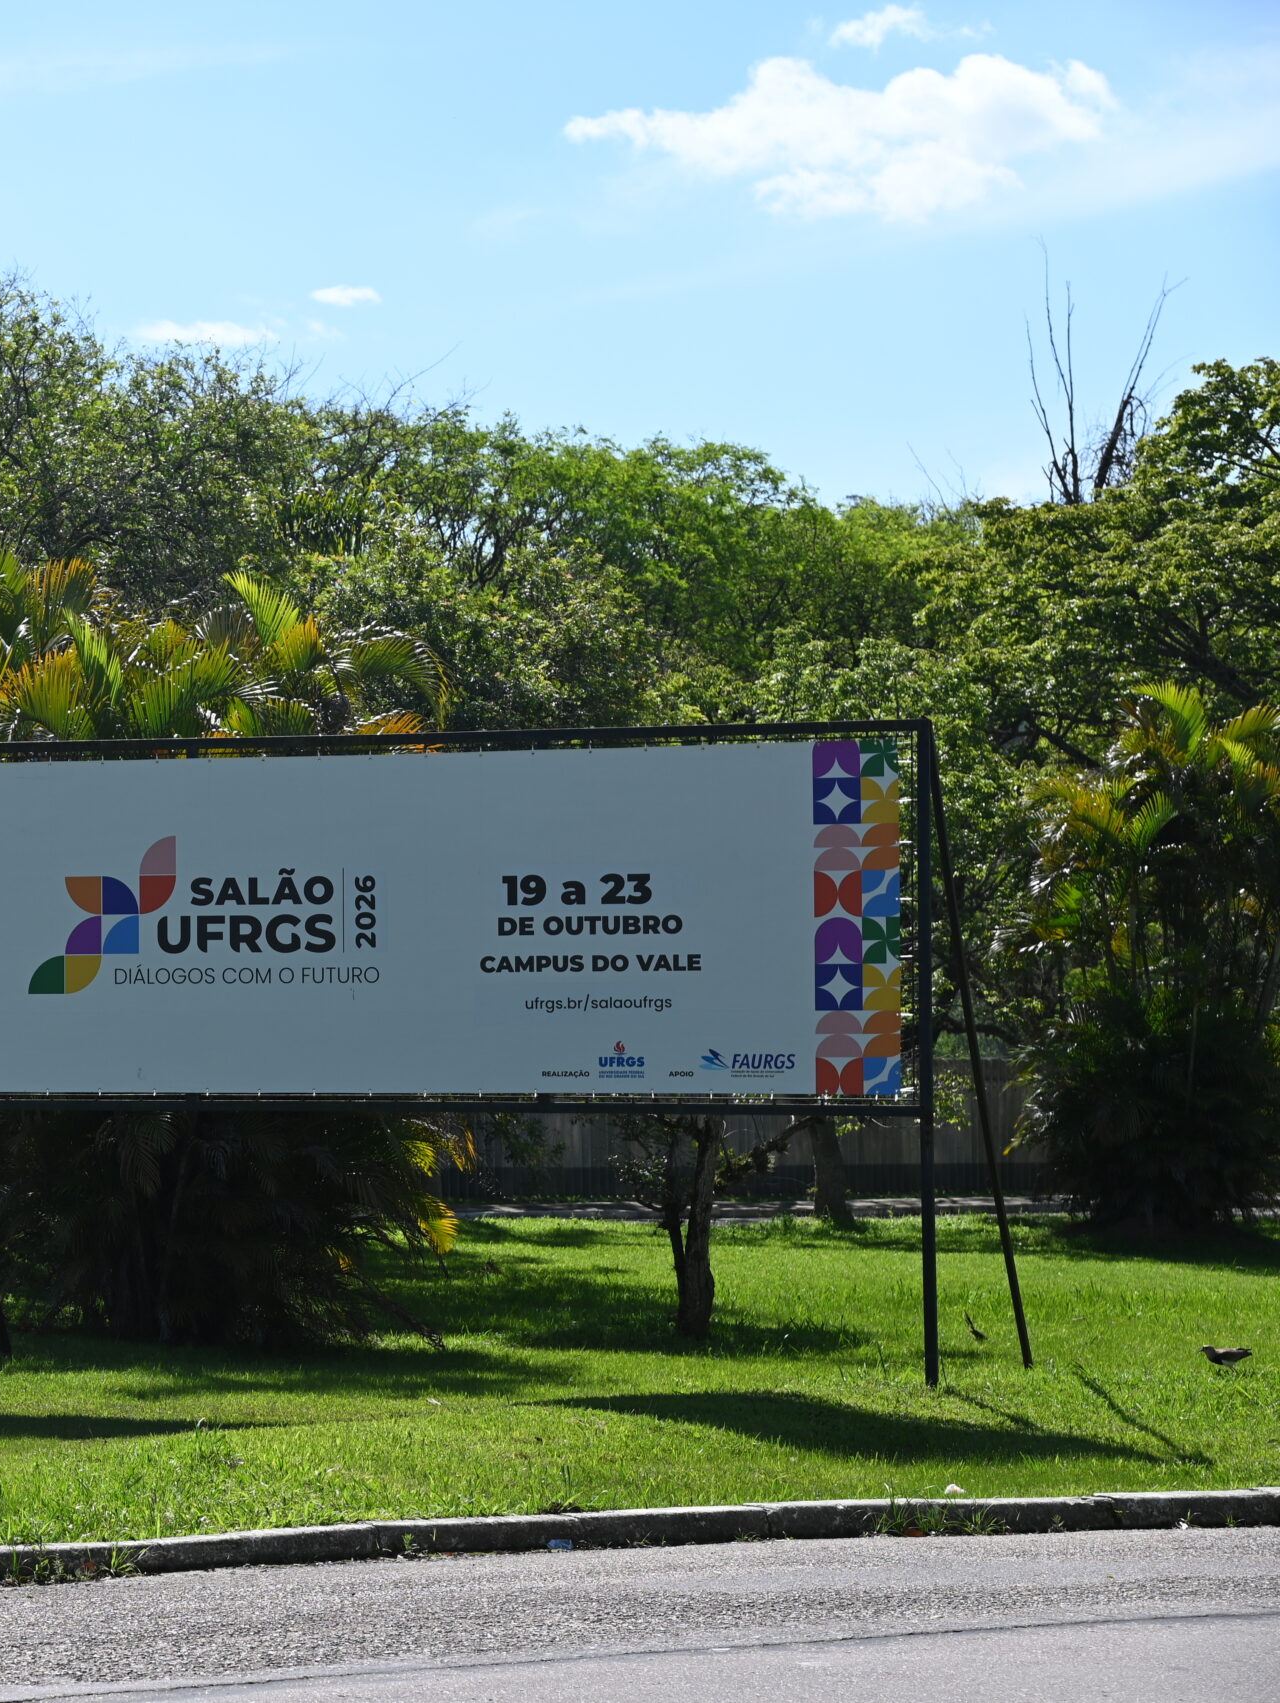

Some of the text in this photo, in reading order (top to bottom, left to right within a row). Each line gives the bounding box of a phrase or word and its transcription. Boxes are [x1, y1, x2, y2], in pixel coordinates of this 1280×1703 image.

[191, 868, 334, 906] SALÃO
[502, 874, 652, 906] 19 a 23
[355, 875, 376, 949] 2026
[157, 914, 336, 954] UFRGS
[498, 915, 682, 936] DE OUTUBRO
[480, 954, 701, 973] CAMPUS DO VALE
[115, 964, 379, 984] DIÁLOGOS COM O FUTURO
[526, 994, 672, 1013] ufrgs.br/salaoufrgs
[599, 1055, 644, 1067] UFRGS
[732, 1054, 795, 1069] FAURGS
[542, 1069, 590, 1079] REALIZAÇÃO
